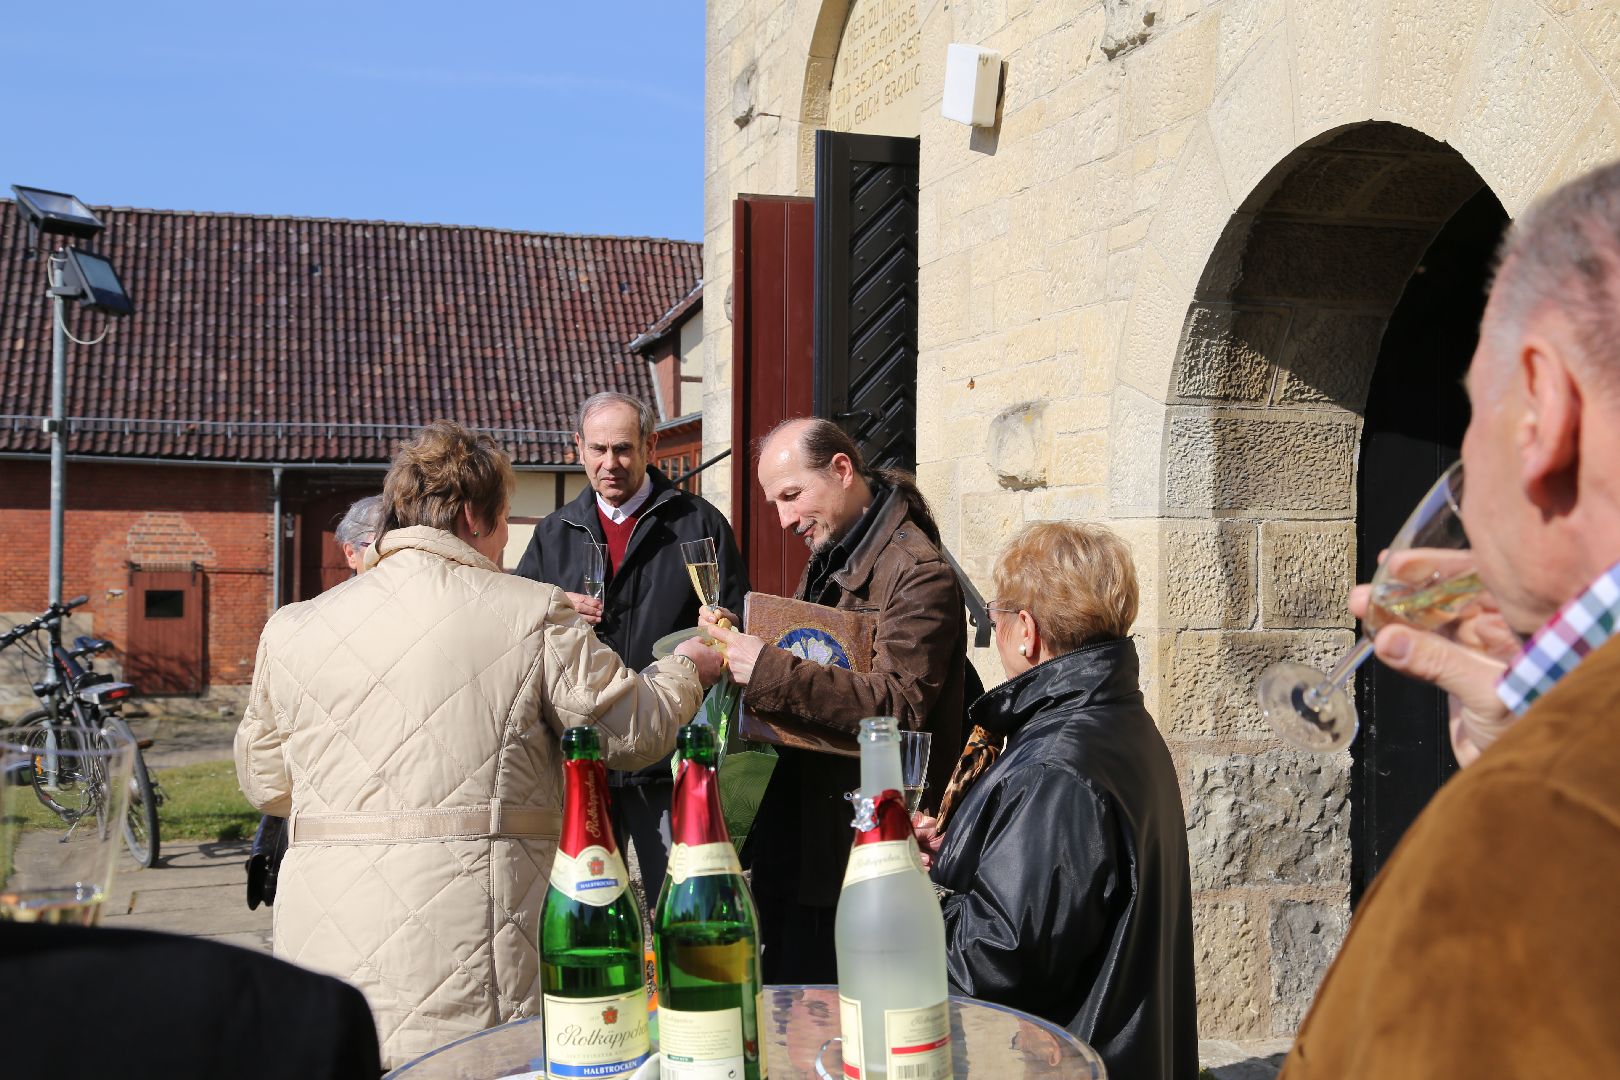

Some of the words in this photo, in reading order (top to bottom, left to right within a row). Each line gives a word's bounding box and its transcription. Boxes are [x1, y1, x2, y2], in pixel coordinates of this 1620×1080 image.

[879, 4, 918, 50] MÜHSE
[884, 63, 920, 106] ERQUIC
[557, 1019, 648, 1049] Rotkäppche
[583, 1061, 638, 1076] HALBTROCKEN
